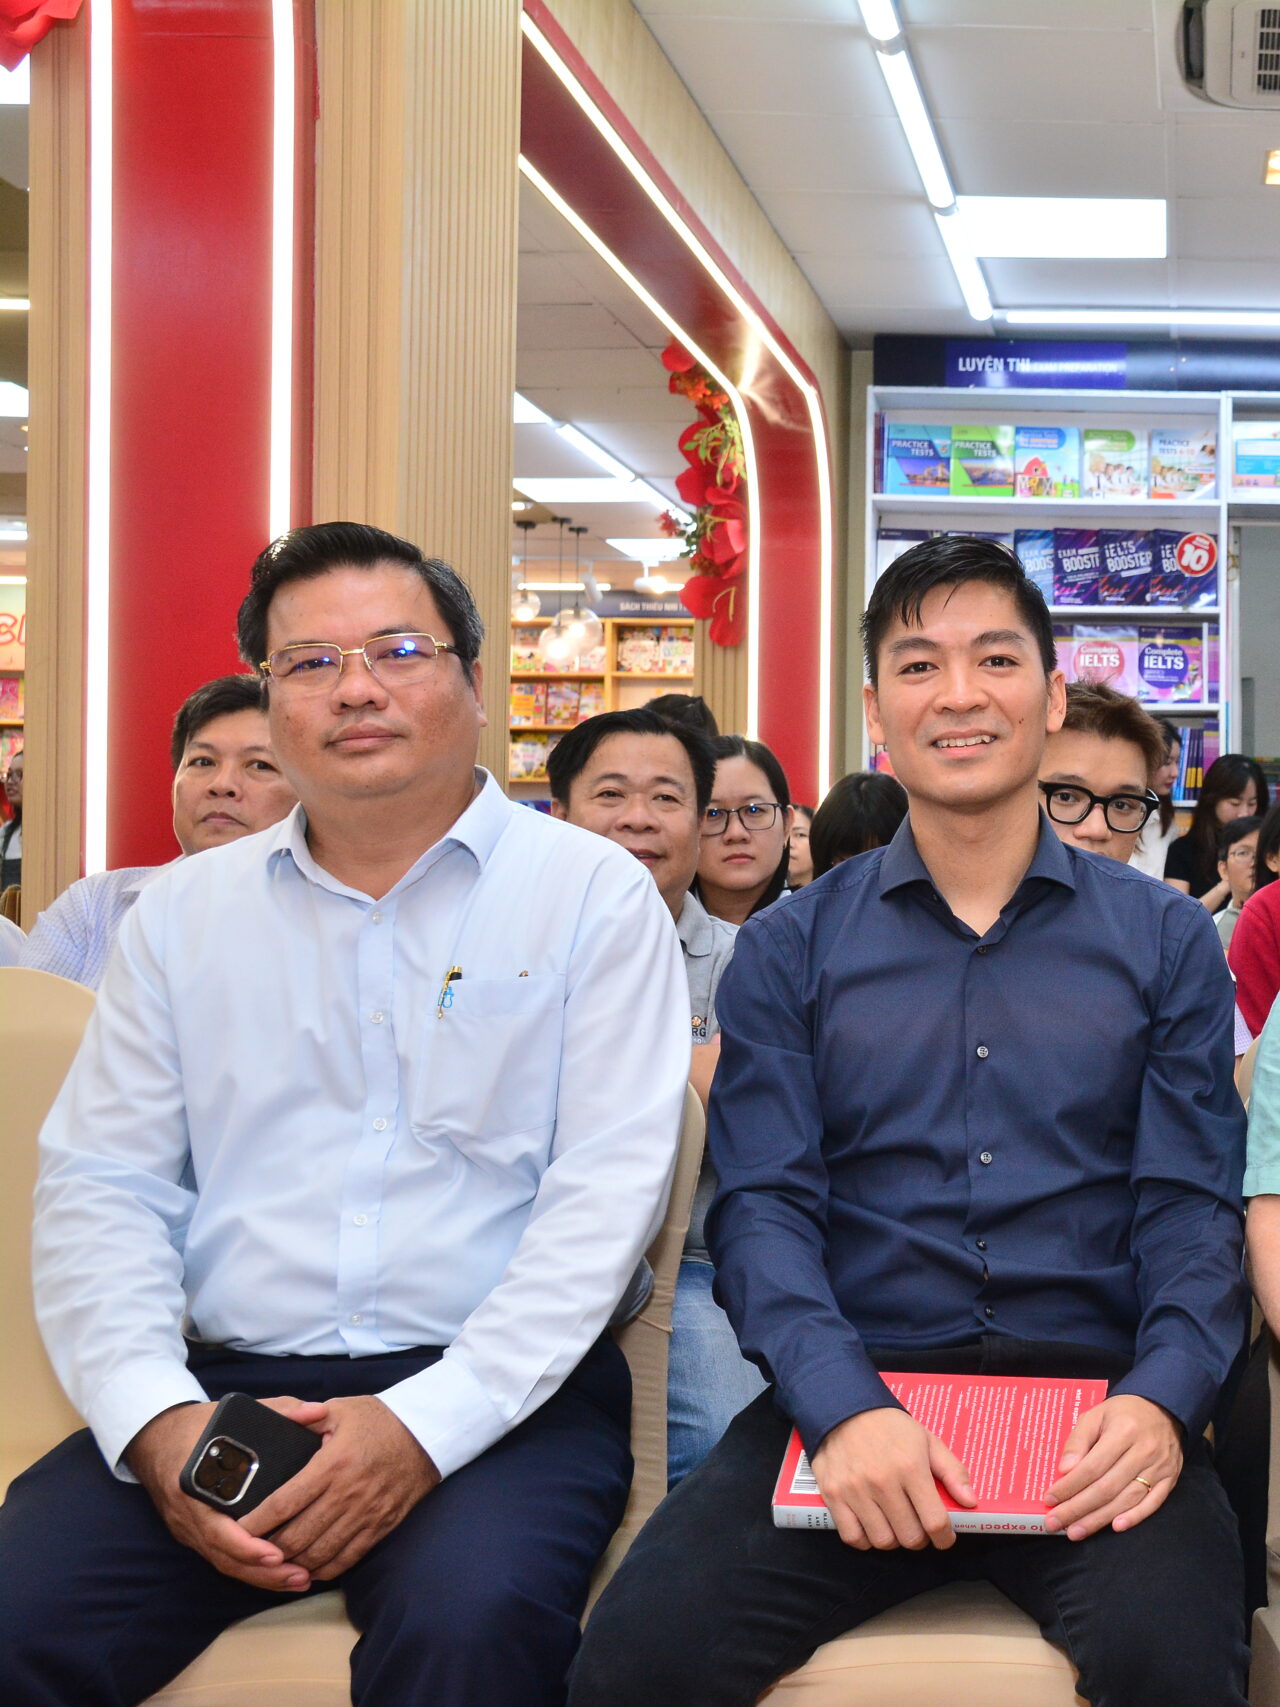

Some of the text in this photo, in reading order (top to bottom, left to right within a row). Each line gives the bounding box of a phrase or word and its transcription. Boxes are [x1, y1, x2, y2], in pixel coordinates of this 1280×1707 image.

[892, 440, 929, 449] PRACTICE
[955, 440, 993, 450] PRACTICE
[1159, 439, 1190, 447] PRACTICE
[911, 448, 935, 457] TESTS
[973, 449, 997, 458] TESTS
[1106, 551, 1152, 573] BOOSTER
[1181, 543, 1209, 572] 10
[1024, 555, 1054, 573] BOOS
[1062, 554, 1099, 573] BOOST
[1080, 645, 1118, 655] Complete
[1144, 647, 1183, 657] Complete
[1079, 654, 1120, 668] IELTS
[1143, 656, 1184, 670] IELTS
[691, 1027, 707, 1037] RG
[980, 1523, 1026, 1531] expect
[1030, 1524, 1044, 1532] to
